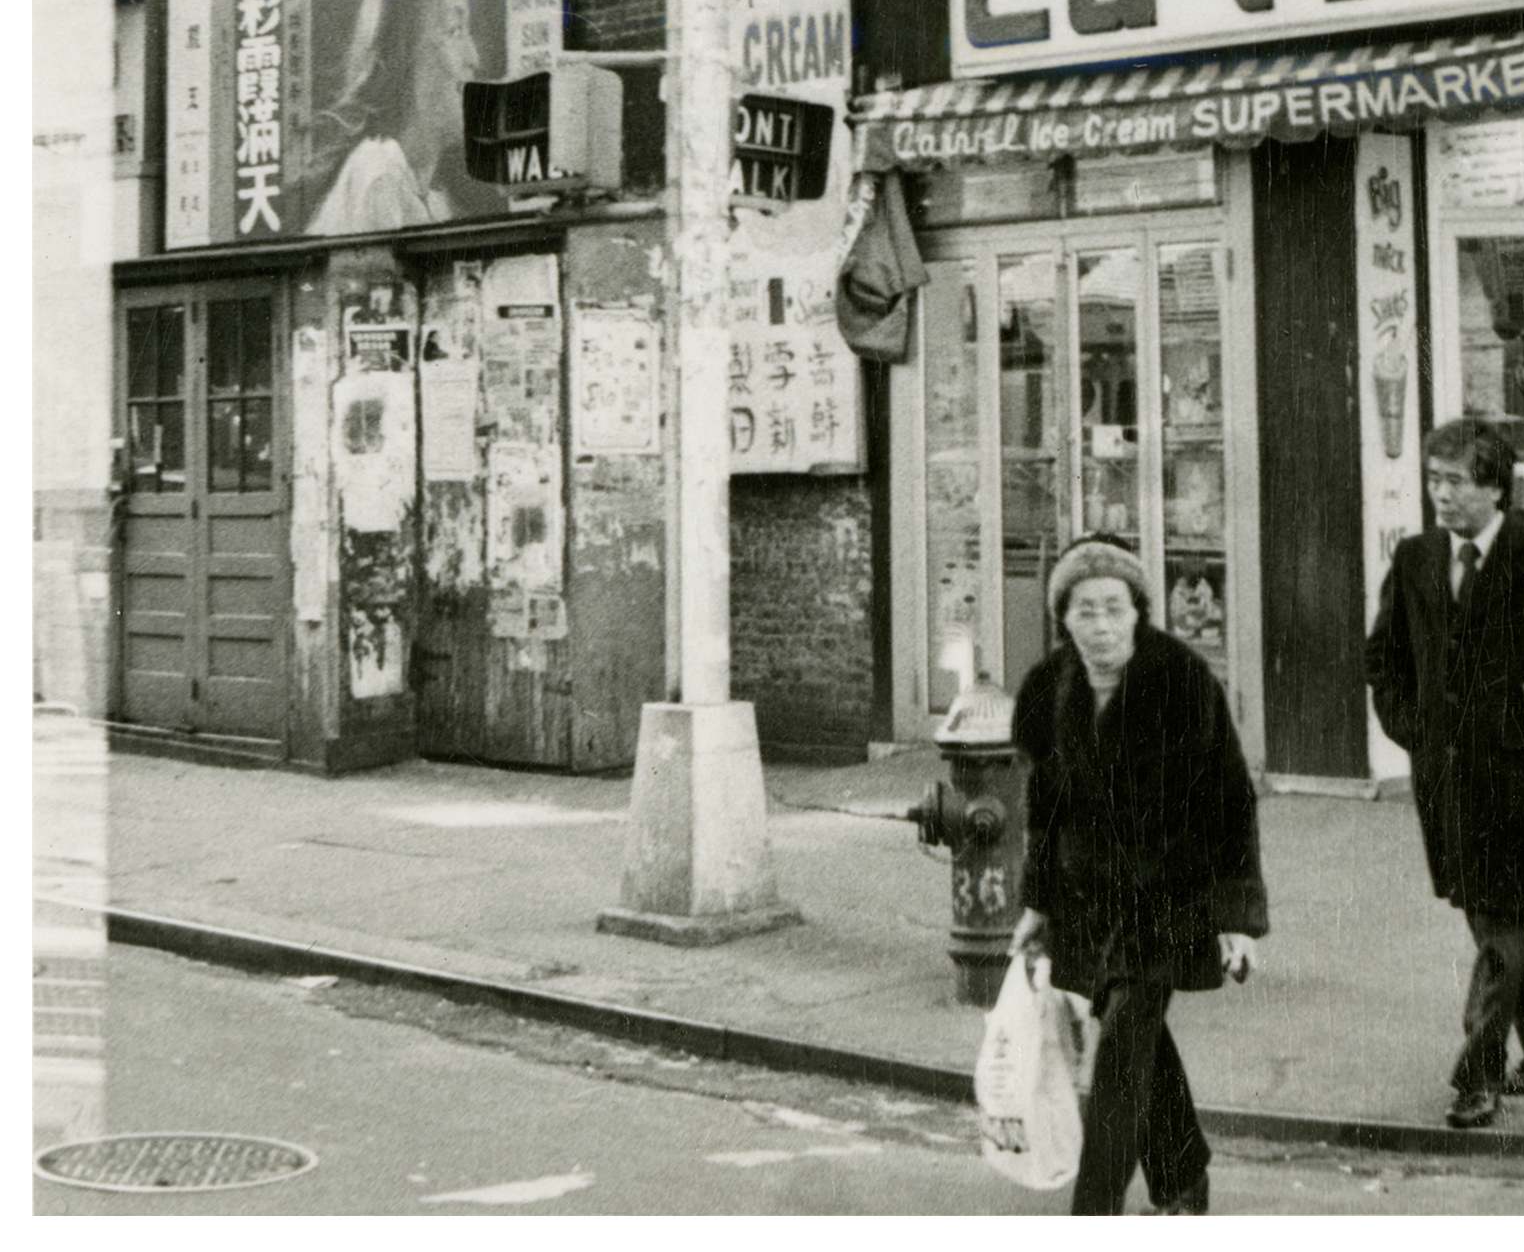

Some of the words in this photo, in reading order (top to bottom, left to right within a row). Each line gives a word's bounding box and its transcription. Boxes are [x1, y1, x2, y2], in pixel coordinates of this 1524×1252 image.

[742, 11, 845, 87] CREAM
[733, 105, 793, 149] ONT
[1029, 119, 1070, 151] Ice
[1083, 113, 1176, 147] Cream
[728, 157, 789, 199] ALK
